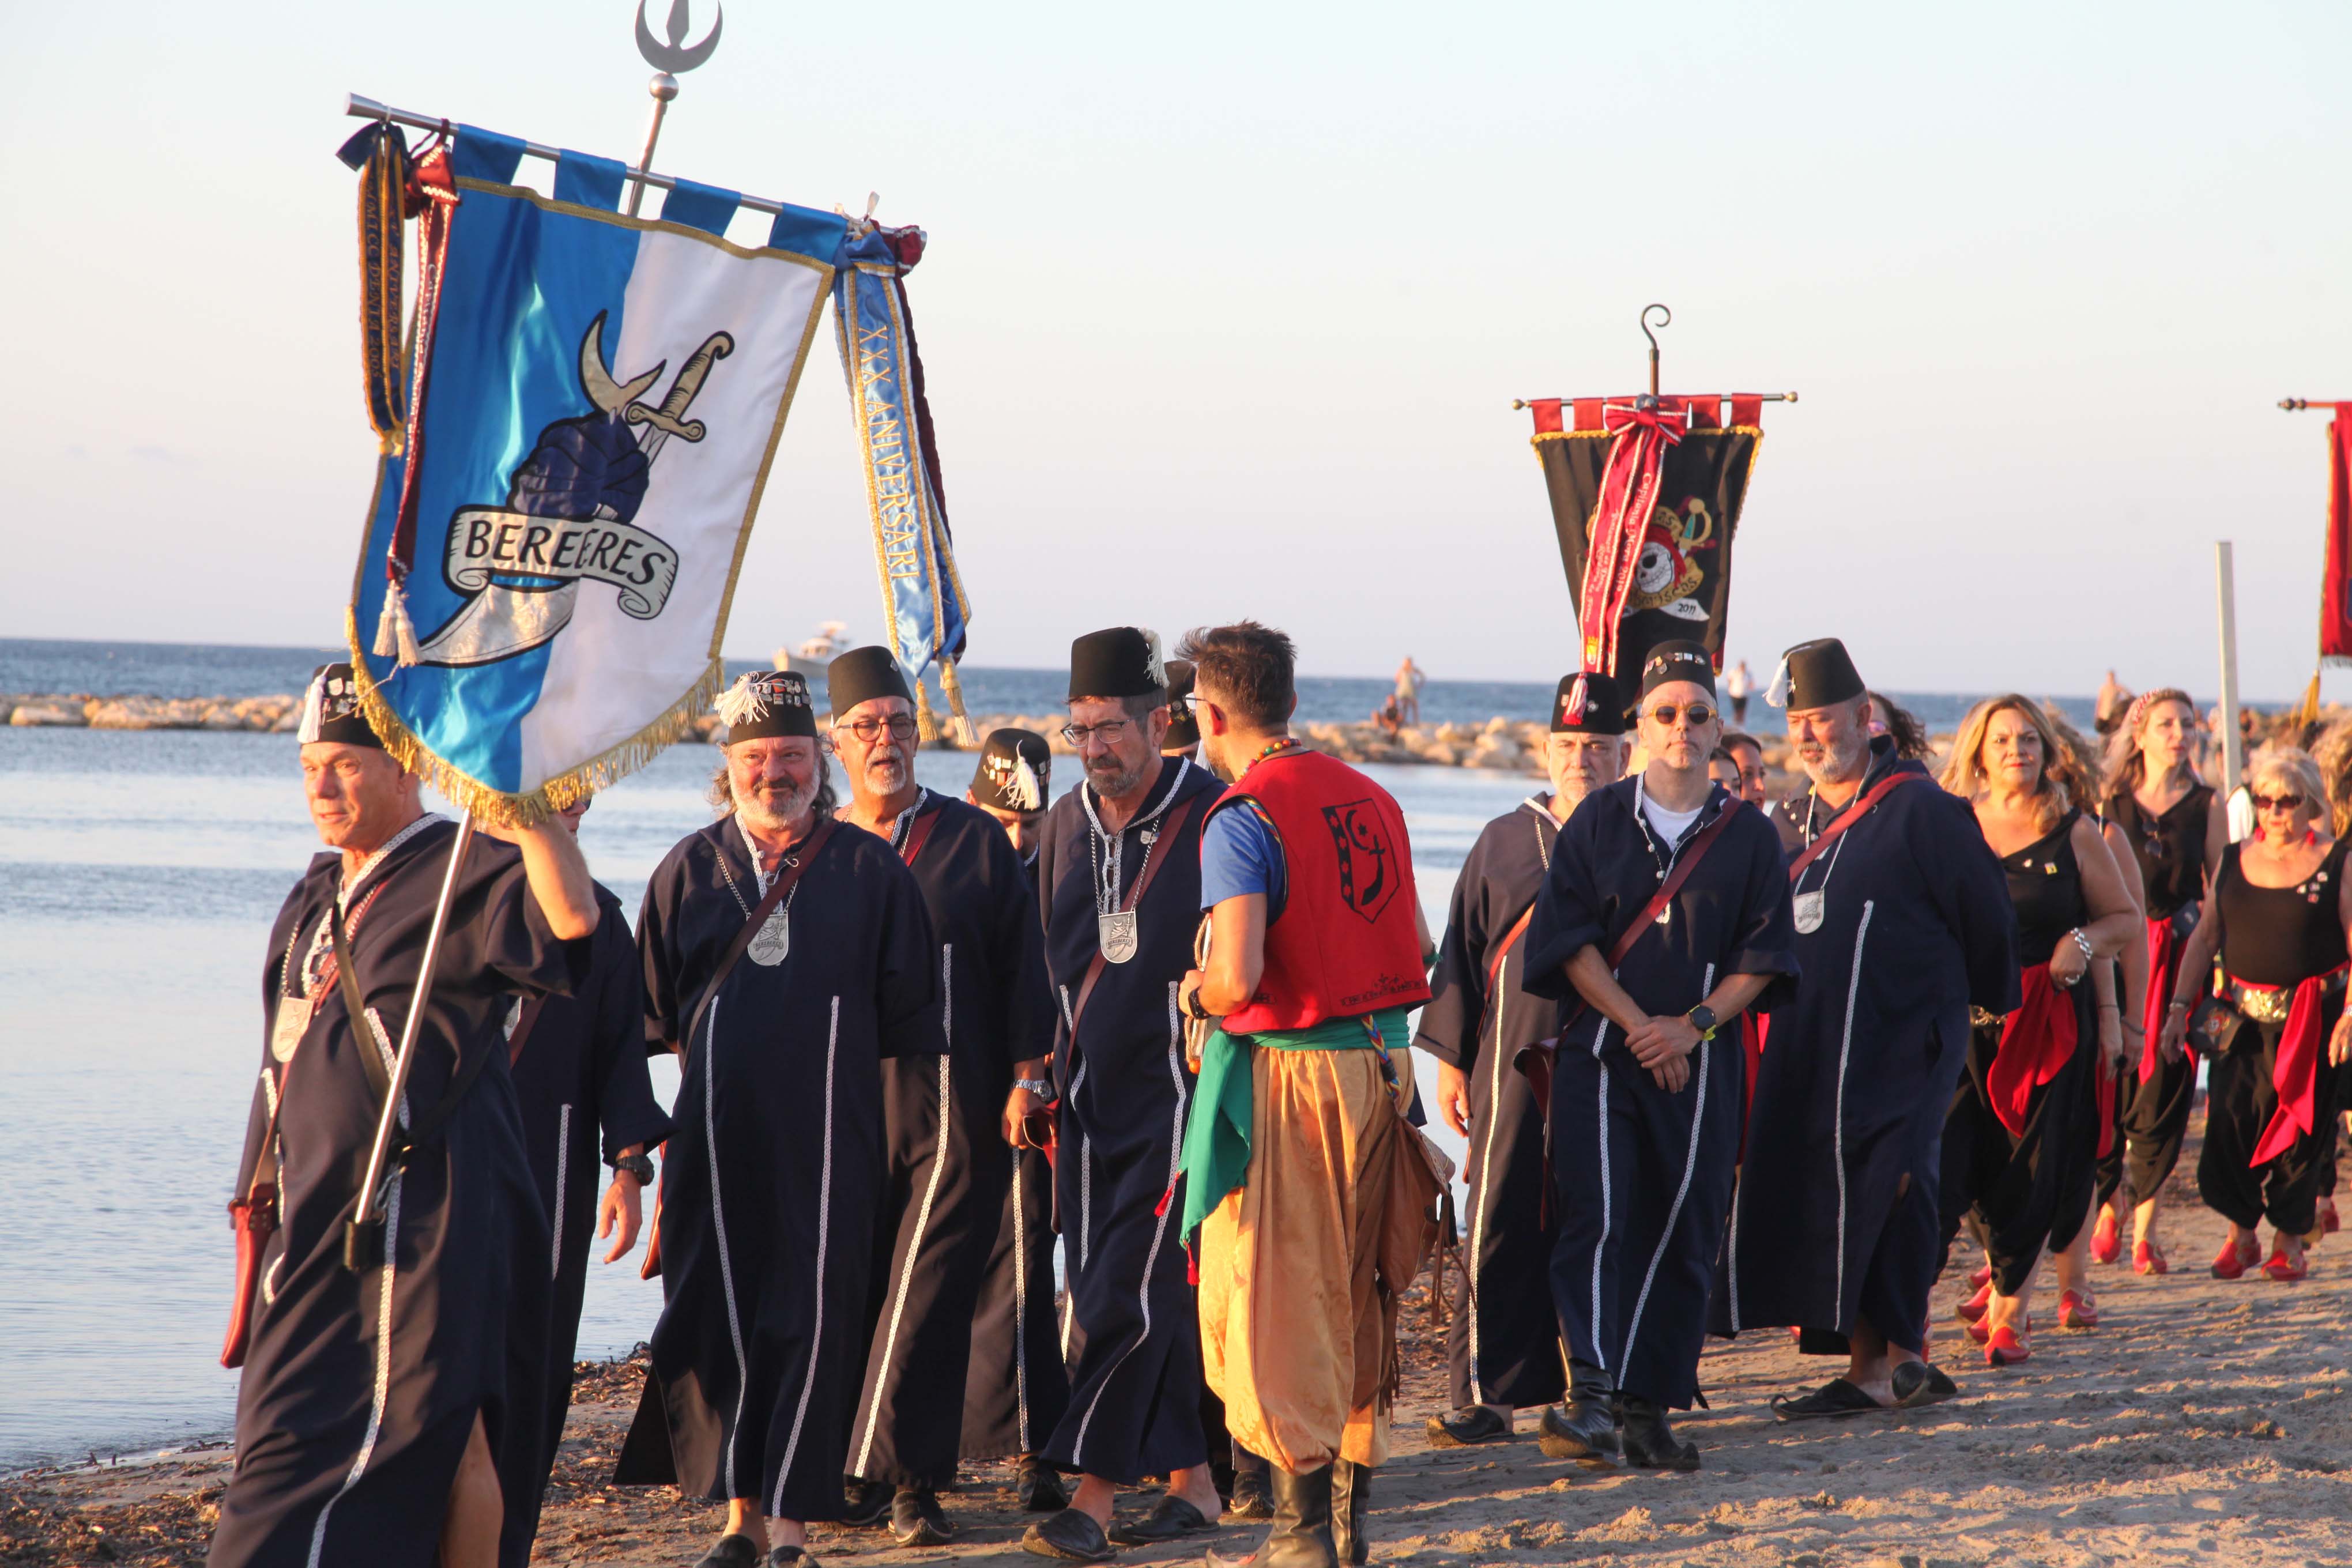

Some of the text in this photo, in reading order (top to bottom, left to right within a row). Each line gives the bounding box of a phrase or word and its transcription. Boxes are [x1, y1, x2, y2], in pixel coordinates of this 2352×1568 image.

[858, 325, 921, 579] XXX ANIVERSARI
[1678, 603, 1697, 615] 2011
